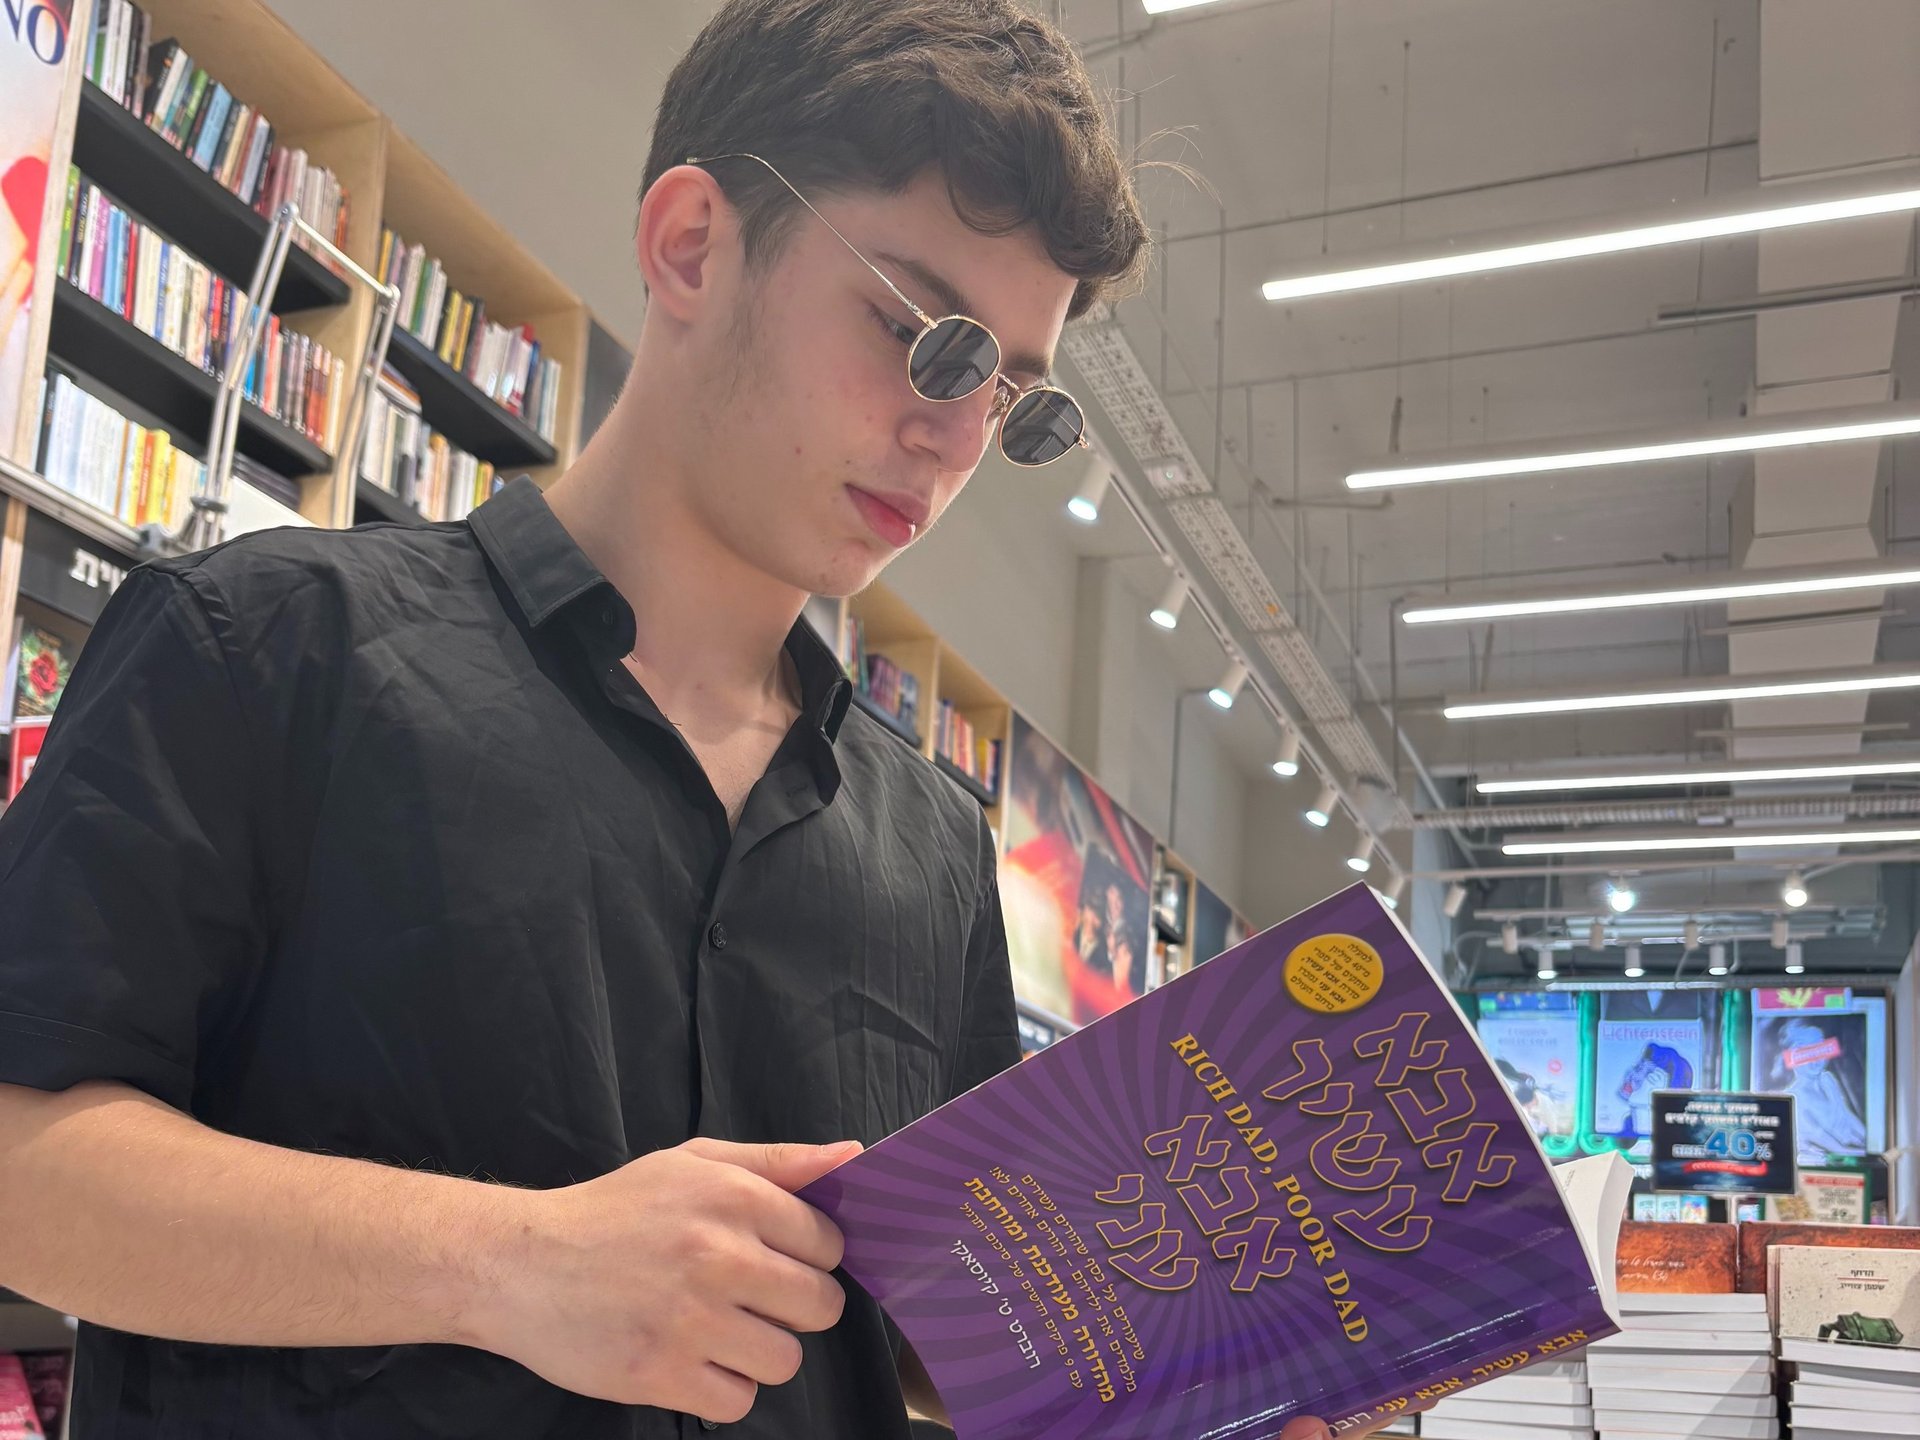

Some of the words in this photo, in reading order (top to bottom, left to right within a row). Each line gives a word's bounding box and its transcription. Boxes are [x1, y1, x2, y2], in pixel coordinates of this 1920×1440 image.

[1301, 956, 1324, 971] עשיר,
[1314, 947, 1331, 962] ספרי
[1329, 946, 1352, 963] מיליון
[1330, 960, 1343, 971] של
[1347, 944, 1372, 962] למעלה
[1290, 975, 1314, 994] העולם
[1298, 966, 1318, 983] נמכרו
[1319, 982, 1330, 992] עני
[1323, 970, 1339, 984] אבא
[1342, 970, 1370, 991] עותקים
[1314, 993, 1335, 1010] ברחבי
[1329, 990, 1346, 1004] אבא
[1339, 983, 1360, 999] סדרת
[1602, 1024, 1699, 1041] Lichtenstein
[1354, 1012, 1516, 1202] אבא
[1262, 1038, 1432, 1252] עשיר
[989, 1166, 1010, 1184] לא!
[1170, 1032, 1237, 1102] RICH
[1224, 1102, 1278, 1174] DAD,
[1273, 1173, 1336, 1266] POOR
[1324, 1269, 1368, 1342] DAD
[1007, 1185, 1039, 1220] אחרים
[1021, 1174, 1057, 1212] עשירים
[1144, 1114, 1297, 1291] אבא
[960, 1202, 987, 1232] ותרגיל
[964, 1177, 1028, 1242] ומורחבת
[1036, 1220, 1067, 1256] והורים
[1054, 1213, 1088, 1255] שהורים
[1095, 1173, 1199, 1290] עני
[985, 1232, 1011, 1261] סיכום
[951, 1239, 999, 1295] קיוסאקי
[1009, 1260, 1024, 1278] של
[1084, 1258, 1105, 1283] כסף
[1022, 1244, 1079, 1320] מעודכנת
[1071, 1270, 1102, 1311] ילדיהם
[1102, 1283, 1117, 1302] על
[1021, 1280, 1048, 1317] חדשים
[1045, 1318, 1068, 1356] פרקים
[1096, 1315, 1114, 1337] את
[1113, 1306, 1145, 1360] שיעורים
[1009, 1319, 1041, 1370] רוברט
[1540, 1328, 1588, 1355] אבא
[1065, 1358, 1074, 1367] 9
[1072, 1325, 1116, 1403] מהדורה
[1109, 1340, 1137, 1392] מלמדים
[1471, 1350, 1530, 1383] עשיר,
[1069, 1369, 1083, 1389] עם
[1415, 1377, 1463, 1400] אבא
[1376, 1396, 1408, 1413] עני
